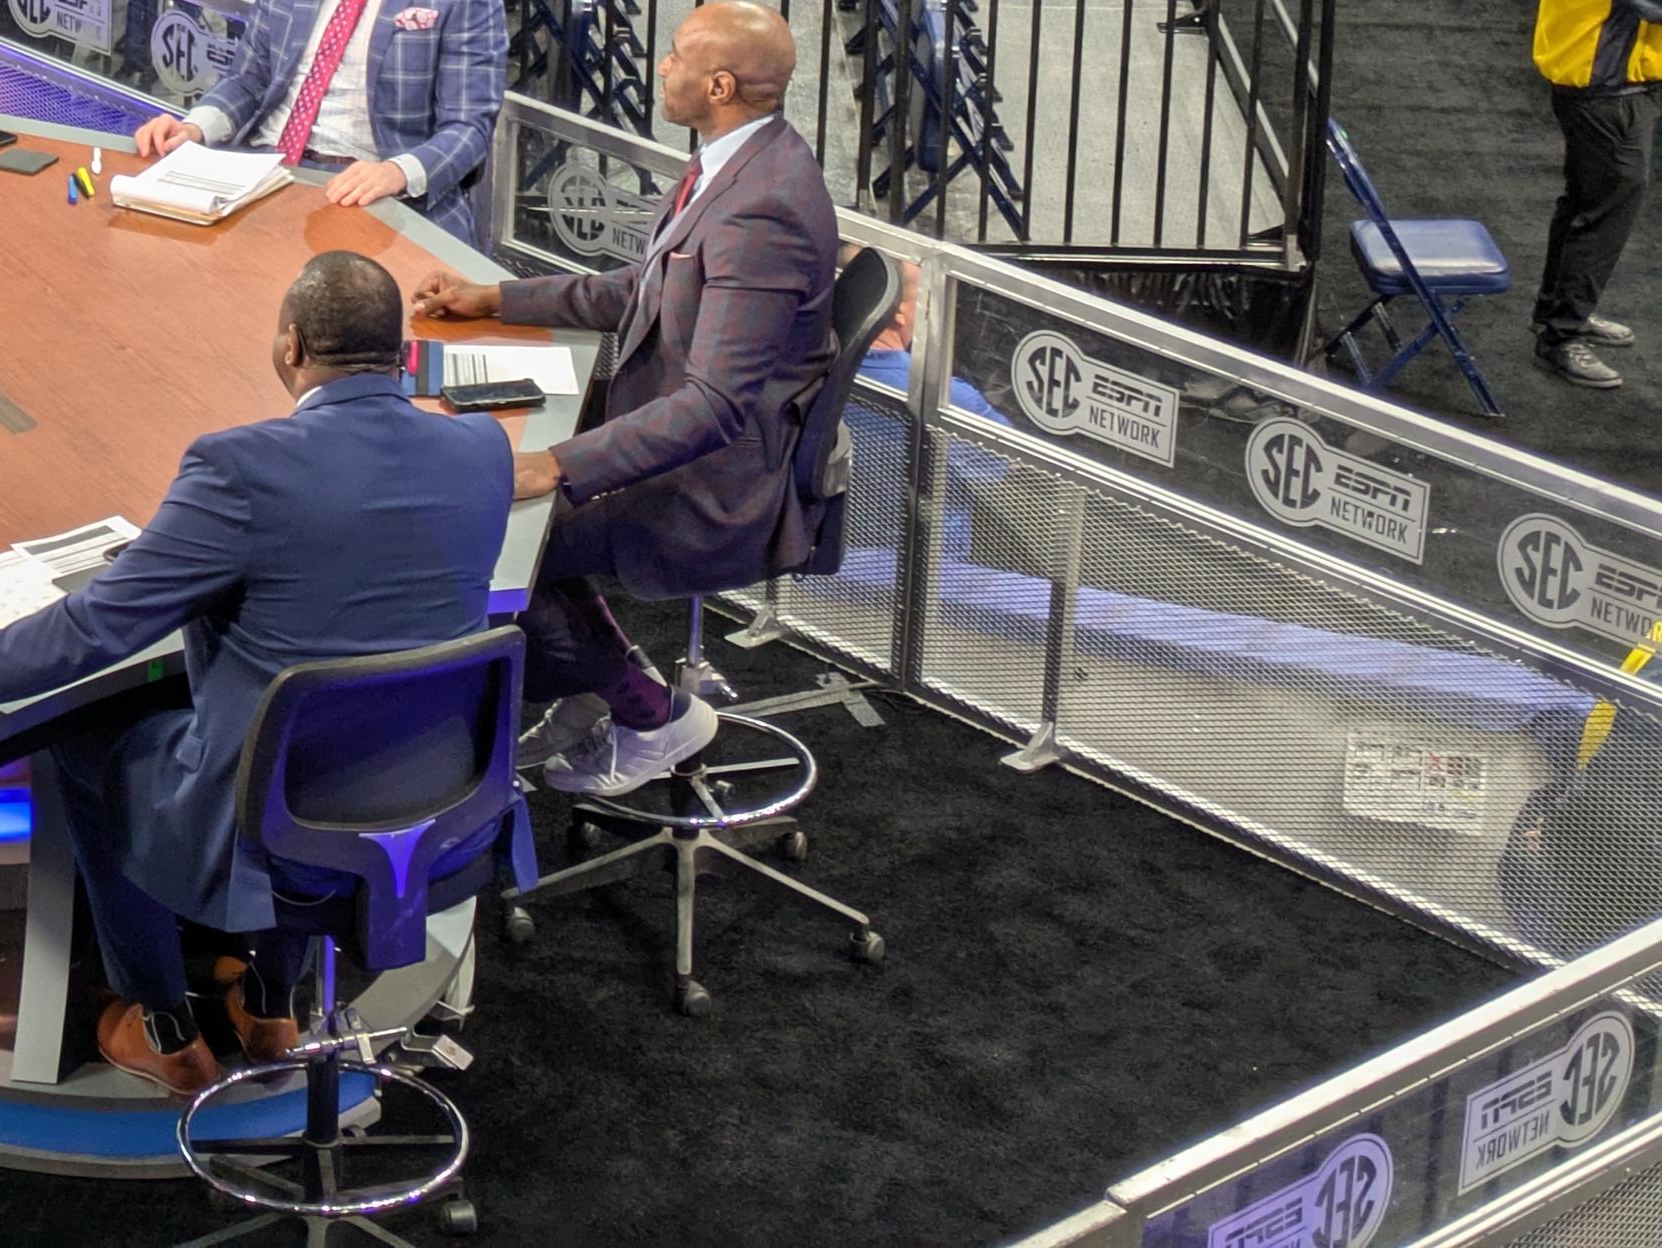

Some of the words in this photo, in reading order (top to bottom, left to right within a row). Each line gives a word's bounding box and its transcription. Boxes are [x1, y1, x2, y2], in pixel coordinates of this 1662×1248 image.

[161, 23, 198, 81] SEC
[1025, 345, 1082, 419] SEC
[1091, 374, 1162, 418] ESPN
[1088, 406, 1160, 449] NETWORK
[1261, 433, 1323, 510] SEC
[1333, 465, 1411, 512] ESPN
[1329, 497, 1407, 545] NETWORK
[1514, 530, 1583, 610] SEC
